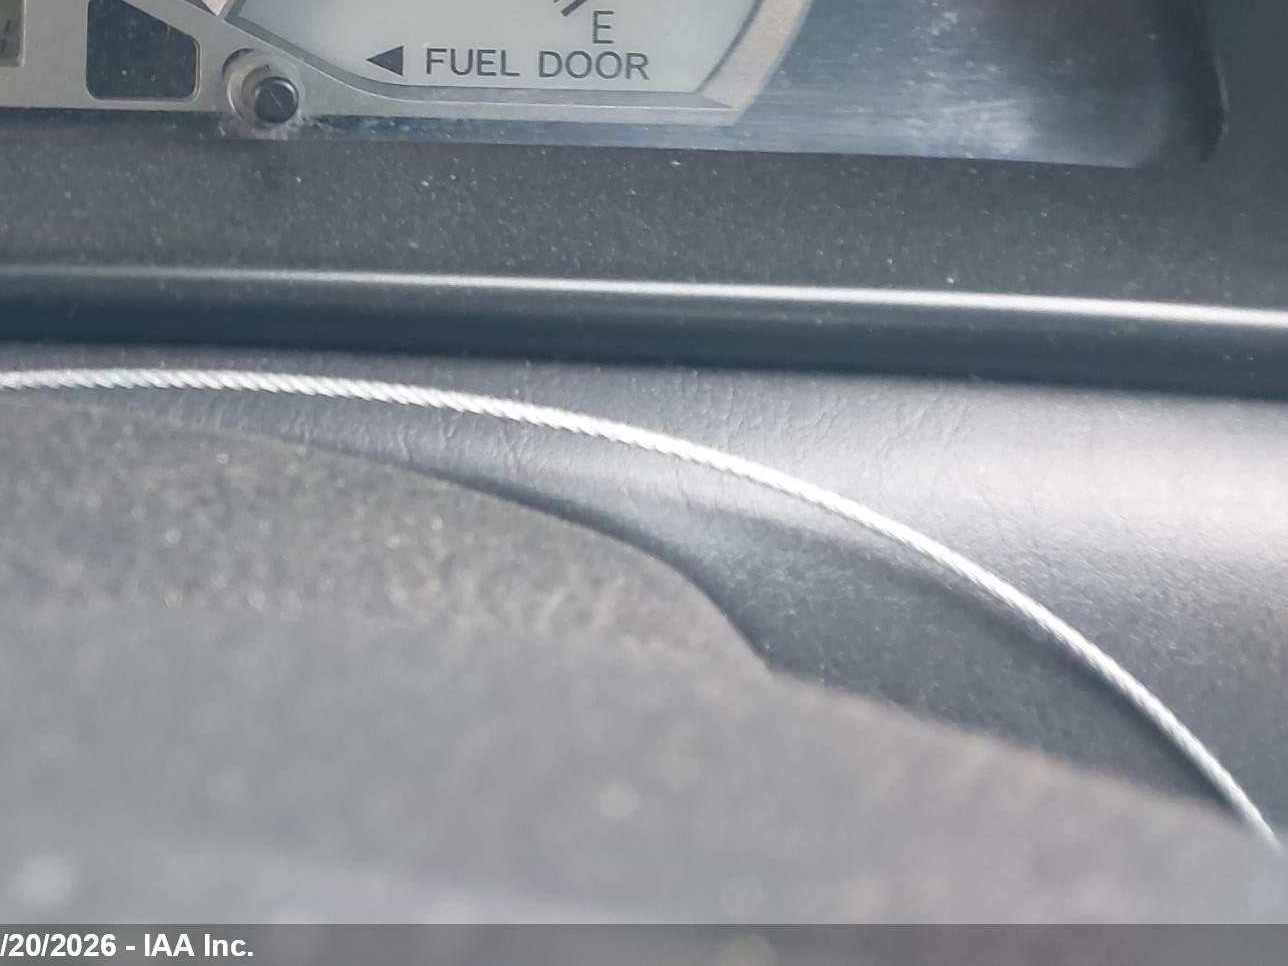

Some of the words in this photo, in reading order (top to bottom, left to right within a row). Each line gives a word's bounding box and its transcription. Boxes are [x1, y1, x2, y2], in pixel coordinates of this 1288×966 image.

[592, 11, 614, 44] E
[426, 49, 520, 77] FUEL
[539, 51, 650, 81] DOOR
